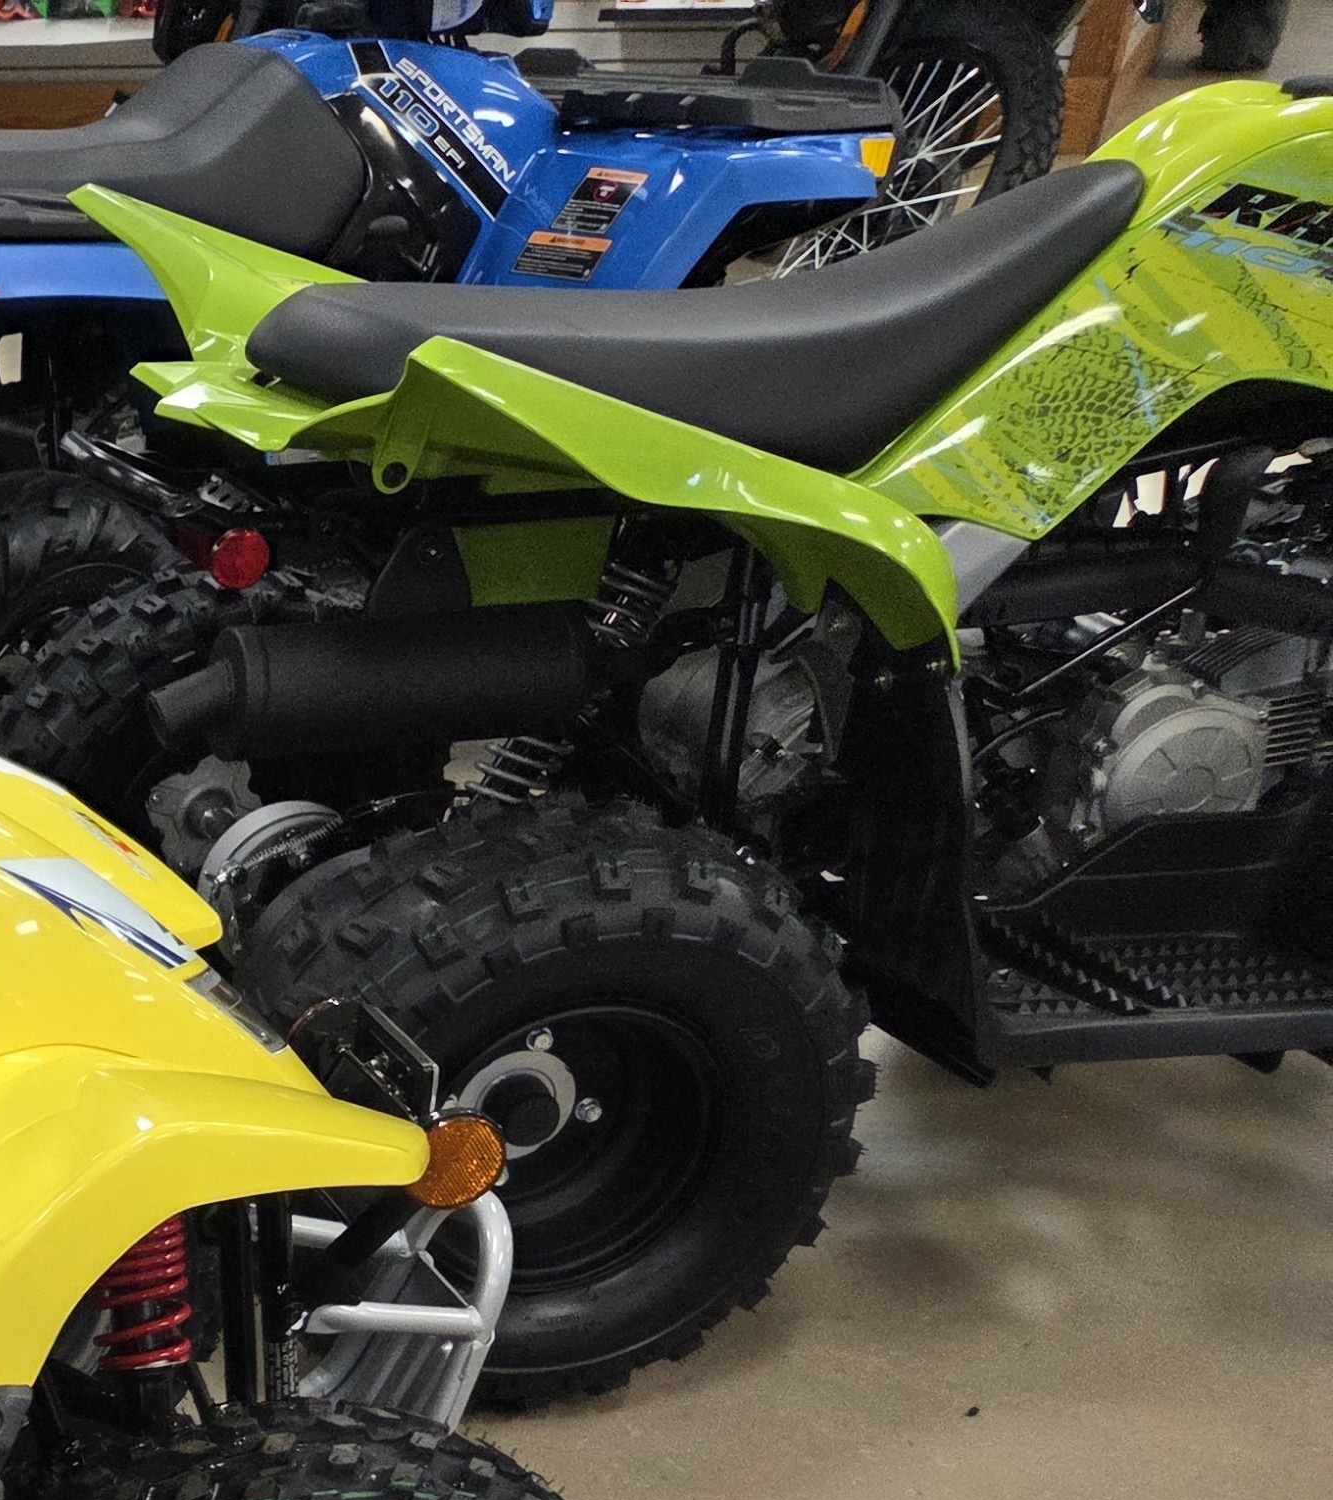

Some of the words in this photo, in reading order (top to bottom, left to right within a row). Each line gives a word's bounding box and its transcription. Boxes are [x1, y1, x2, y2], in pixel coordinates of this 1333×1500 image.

[379, 76, 440, 138] 110
[433, 134, 467, 170] EFI
[395, 57, 517, 183] SPORTSMAN
